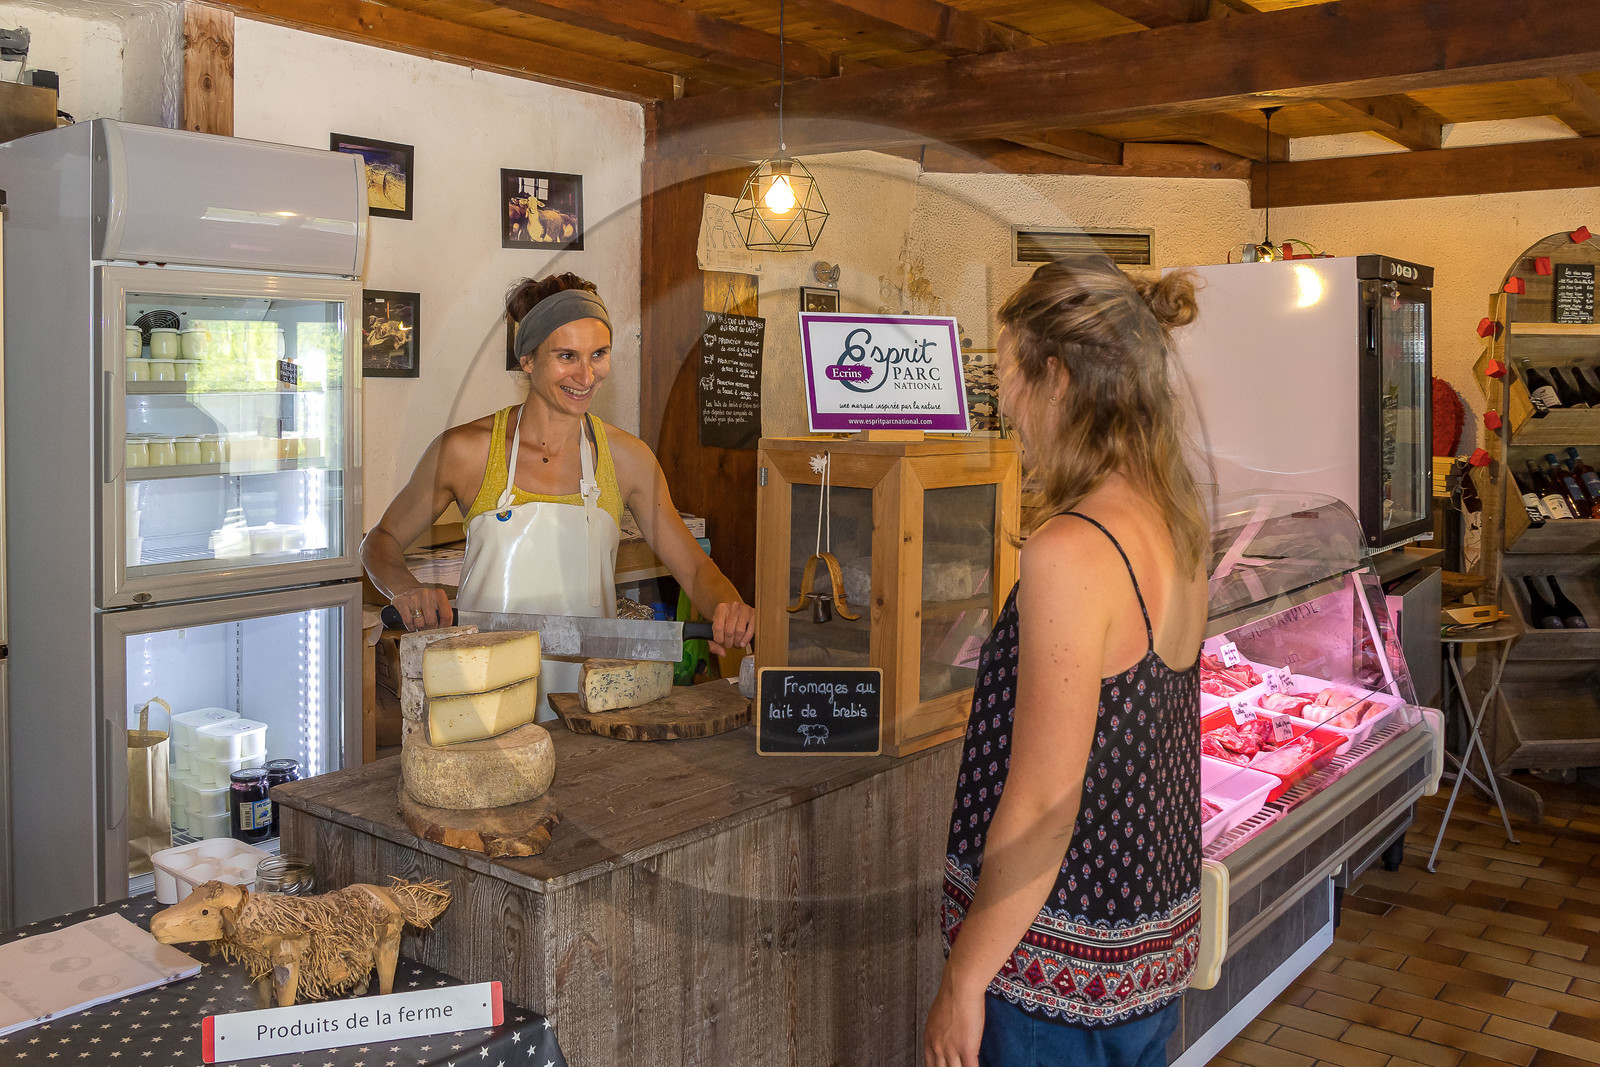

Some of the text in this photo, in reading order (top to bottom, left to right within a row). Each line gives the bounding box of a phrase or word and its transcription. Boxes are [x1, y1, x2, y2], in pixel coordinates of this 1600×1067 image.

[836, 328, 937, 393] Esprit
[832, 368, 862, 378] Ecrins
[893, 366, 941, 381] PARC
[894, 382, 943, 390] NATIONAL
[851, 402, 874, 414] marque
[876, 401, 900, 413] inspirée
[901, 402, 912, 412] par
[913, 400, 920, 410] la
[848, 418, 933, 426] www.espritparcnational.com
[784, 676, 876, 704] Fromages au
[769, 701, 868, 720] lait de brebis
[256, 1004, 453, 1040] Produits de la ferme
